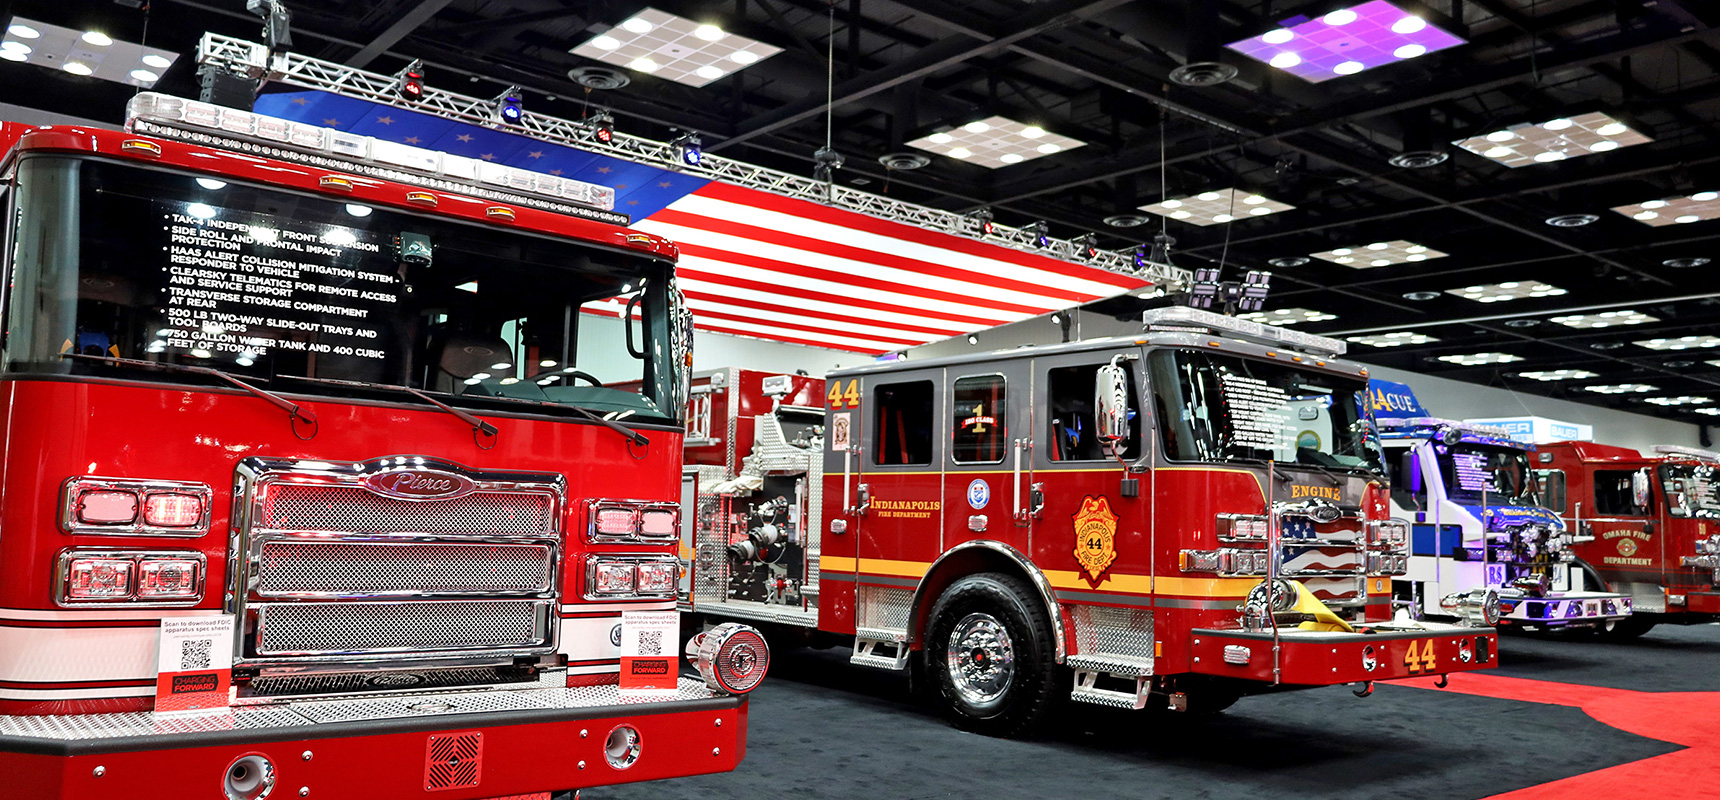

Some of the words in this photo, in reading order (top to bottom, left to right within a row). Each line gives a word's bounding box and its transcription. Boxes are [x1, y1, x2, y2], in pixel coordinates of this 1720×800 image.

[172, 214, 204, 226] TAK-4
[283, 230, 317, 242] FRONT
[172, 226, 197, 236] SIDE
[200, 229, 228, 241] ROLL
[231, 234, 254, 244] AND
[306, 245, 342, 258] IMPACT
[172, 234, 241, 251] PROTECTION
[171, 246, 202, 257] HAAS
[204, 250, 239, 262] ALERT
[241, 255, 296, 270] COLLISION
[298, 262, 355, 278] MITIGATION
[357, 271, 393, 284] SYSTEM
[171, 254, 237, 270] RESPONDER
[239, 263, 254, 272] TO
[257, 265, 300, 279] VEHICLE
[170, 266, 227, 280] CLEARSKY
[229, 273, 292, 289] TELEMATICS
[295, 281, 316, 292] FOR
[318, 285, 358, 298] REMOTE
[360, 291, 397, 303] ACCESS
[170, 275, 195, 285] AND
[197, 278, 243, 291] SERVICE
[245, 284, 293, 297] SUPPORT
[169, 287, 240, 303] TRANSVERSE
[243, 295, 291, 309] STORAGE
[294, 301, 368, 318] COMPARTMENT
[169, 296, 184, 305] AT
[186, 298, 217, 309] REAR
[168, 317, 199, 328] TOOL
[168, 308, 191, 318] 500
[193, 310, 208, 319] LB
[210, 312, 264, 326] TWO-WAY
[266, 318, 320, 332] SLIDE-OUT
[322, 324, 353, 336] TRAYS
[355, 328, 377, 339] AND
[167, 329, 189, 339] 750
[191, 330, 236, 344] GALLON
[278, 340, 306, 351] TANK
[308, 343, 331, 353] AND
[333, 346, 353, 356] 400
[355, 348, 385, 360] CUBIC
[167, 338, 195, 348] FEET
[197, 341, 214, 350] OF
[216, 342, 267, 355] STORAGE
[827, 379, 859, 410] 44
[1551, 426, 1577, 440] BAUER
[391, 472, 452, 492] Pierce
[1291, 485, 1341, 501] ENGINE
[870, 496, 940, 510] INDIANAPOLIS
[1079, 522, 1112, 543] INDIANAPOLIS
[1602, 529, 1632, 540] OMAHA
[1632, 530, 1652, 542] FIRE
[1086, 538, 1102, 550] 44
[1081, 550, 1092, 564] FIRE
[1603, 556, 1652, 566] DEPARTMENT
[188, 619, 217, 627] download
[1403, 639, 1436, 674] 44
[174, 675, 216, 685] CHARGING
[174, 683, 215, 692] FORWARD
